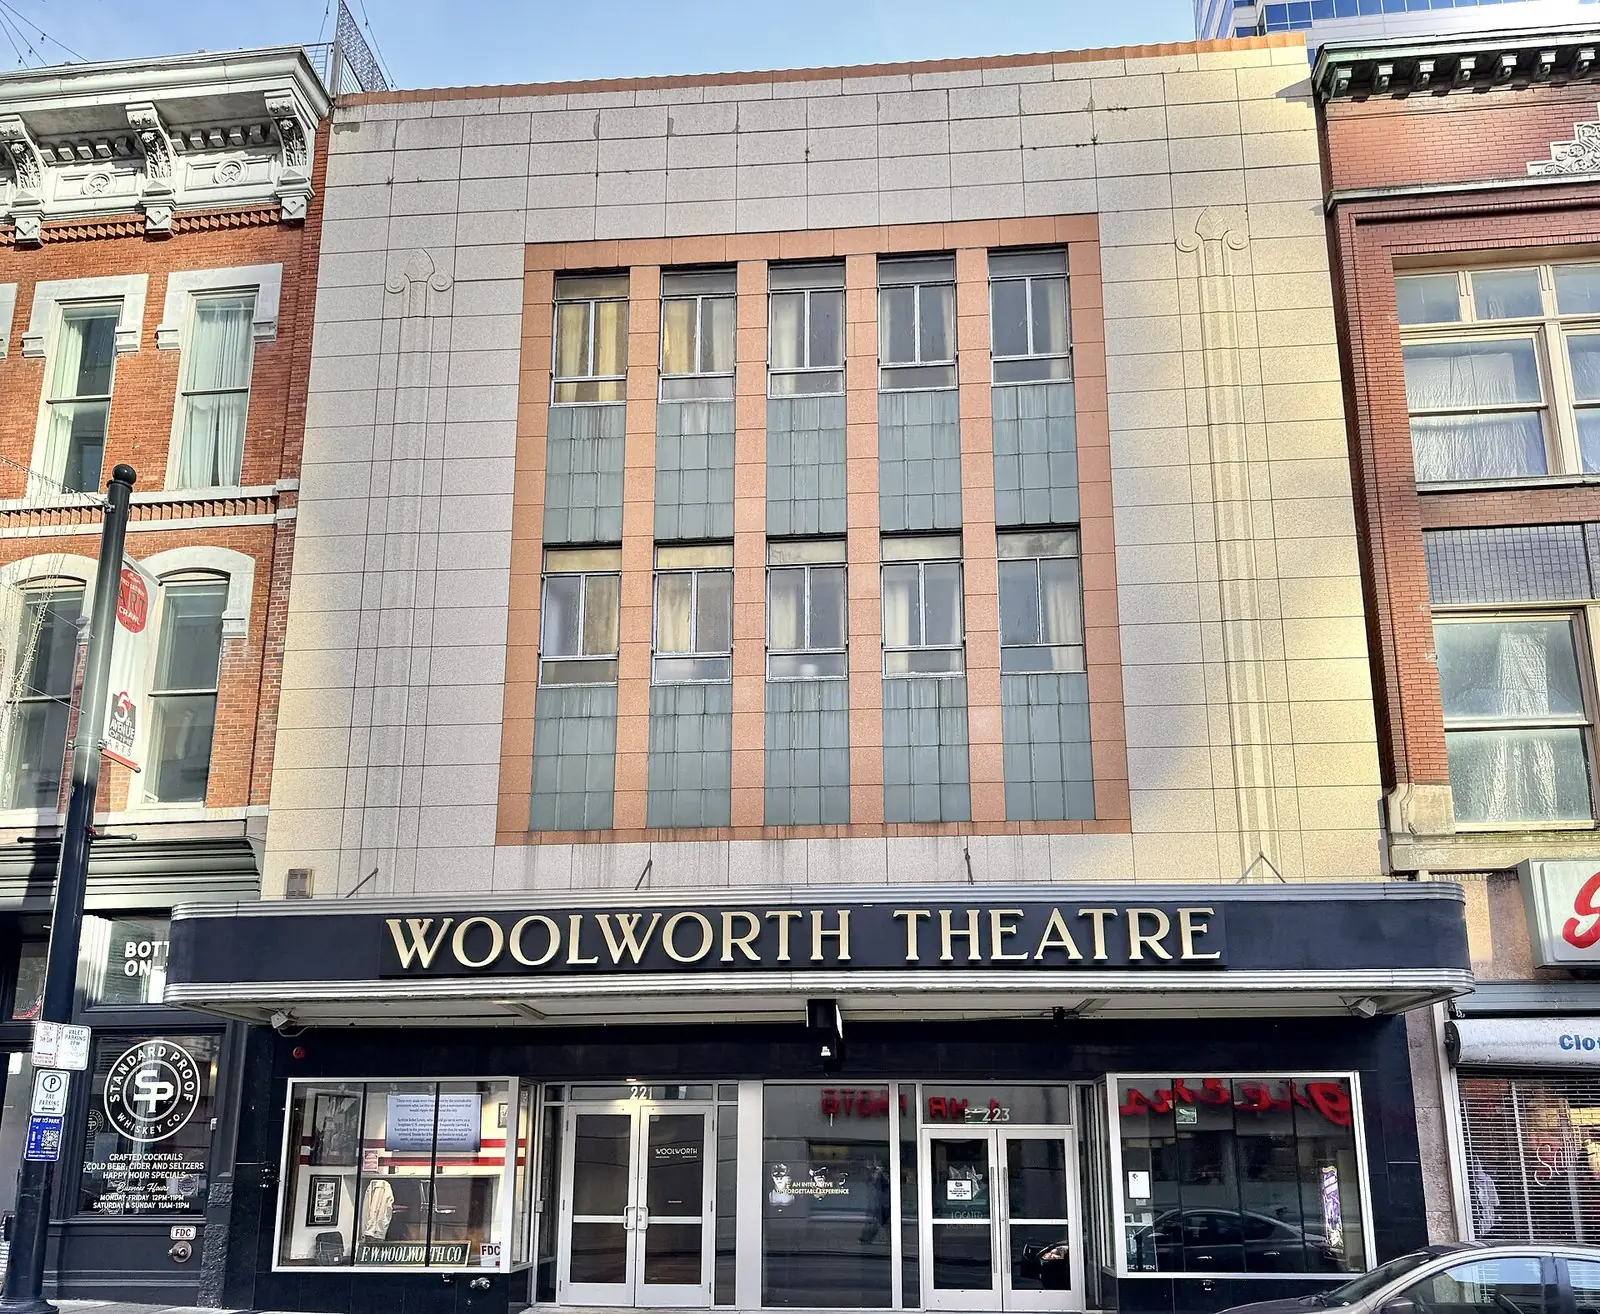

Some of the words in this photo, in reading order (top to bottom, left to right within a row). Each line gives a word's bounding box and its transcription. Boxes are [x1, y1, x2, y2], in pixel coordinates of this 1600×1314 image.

[119, 605, 140, 625] CRAWL
[385, 909, 852, 969] WOOLWORTH
[893, 908, 1221, 960] THEATRE
[1559, 1034, 1600, 1051] Clo
[109, 1046, 167, 1103] STANDARD
[170, 1051, 195, 1102] PROOF
[630, 1086, 653, 1100] 221
[983, 1108, 1010, 1122] 223
[117, 1112, 162, 1135] WHISKEY
[167, 1112, 184, 1127] CO.
[109, 1153, 141, 1161] CRAFTED
[143, 1153, 183, 1161] COCKTAILS
[655, 1147, 698, 1155] WOOLWORTH
[87, 1162, 106, 1170] COLD
[107, 1162, 128, 1171] BEER,
[129, 1162, 151, 1170] CIDER
[152, 1162, 167, 1170] AND
[169, 1162, 204, 1170] SELTZERS
[175, 1228, 191, 1237] FDC
[447, 1246, 462, 1262] CO
[481, 1245, 500, 1256] FDC
